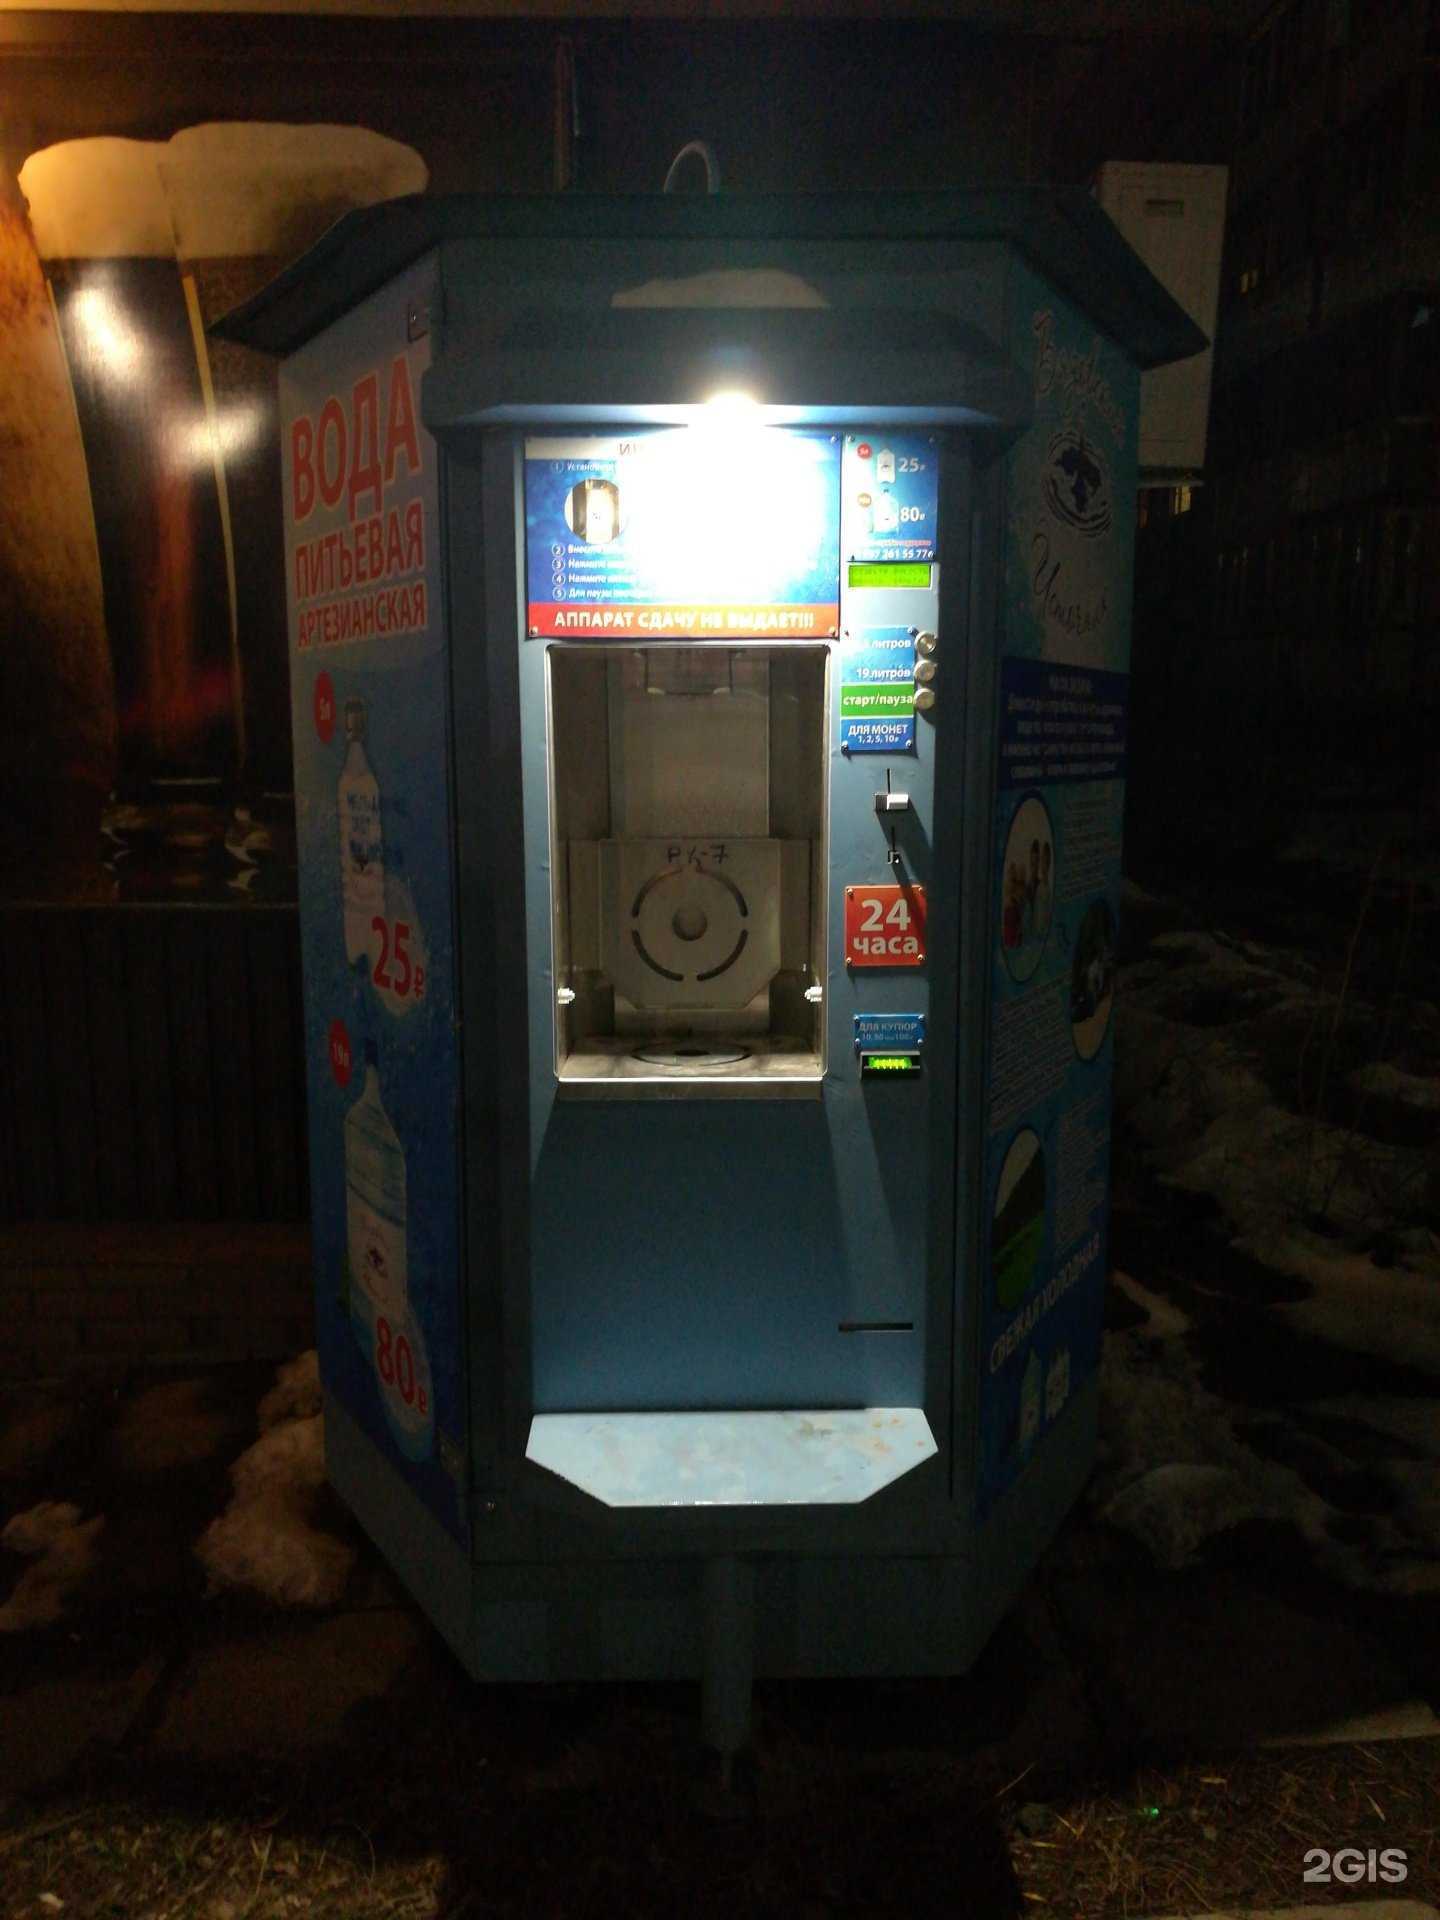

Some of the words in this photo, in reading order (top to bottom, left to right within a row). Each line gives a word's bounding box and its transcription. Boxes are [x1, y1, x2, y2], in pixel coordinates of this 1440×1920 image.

[291, 356, 420, 521] ВОДА
[294, 502, 424, 600] ПИТЬЕВАЯ
[298, 582, 425, 649] АРТЕЗИАНСКАЯ
[554, 611, 634, 627] АППАРАТ
[638, 611, 696, 630] СДАЧУ
[703, 611, 722, 628] НЕ
[857, 667, 870, 679] 19
[871, 668, 911, 681] литров
[843, 692, 913, 708] старт/пауза
[848, 724, 870, 736] ДЛЯ
[872, 724, 908, 735] МОНЕТ
[860, 898, 912, 932] 24
[853, 936, 919, 955] часа
